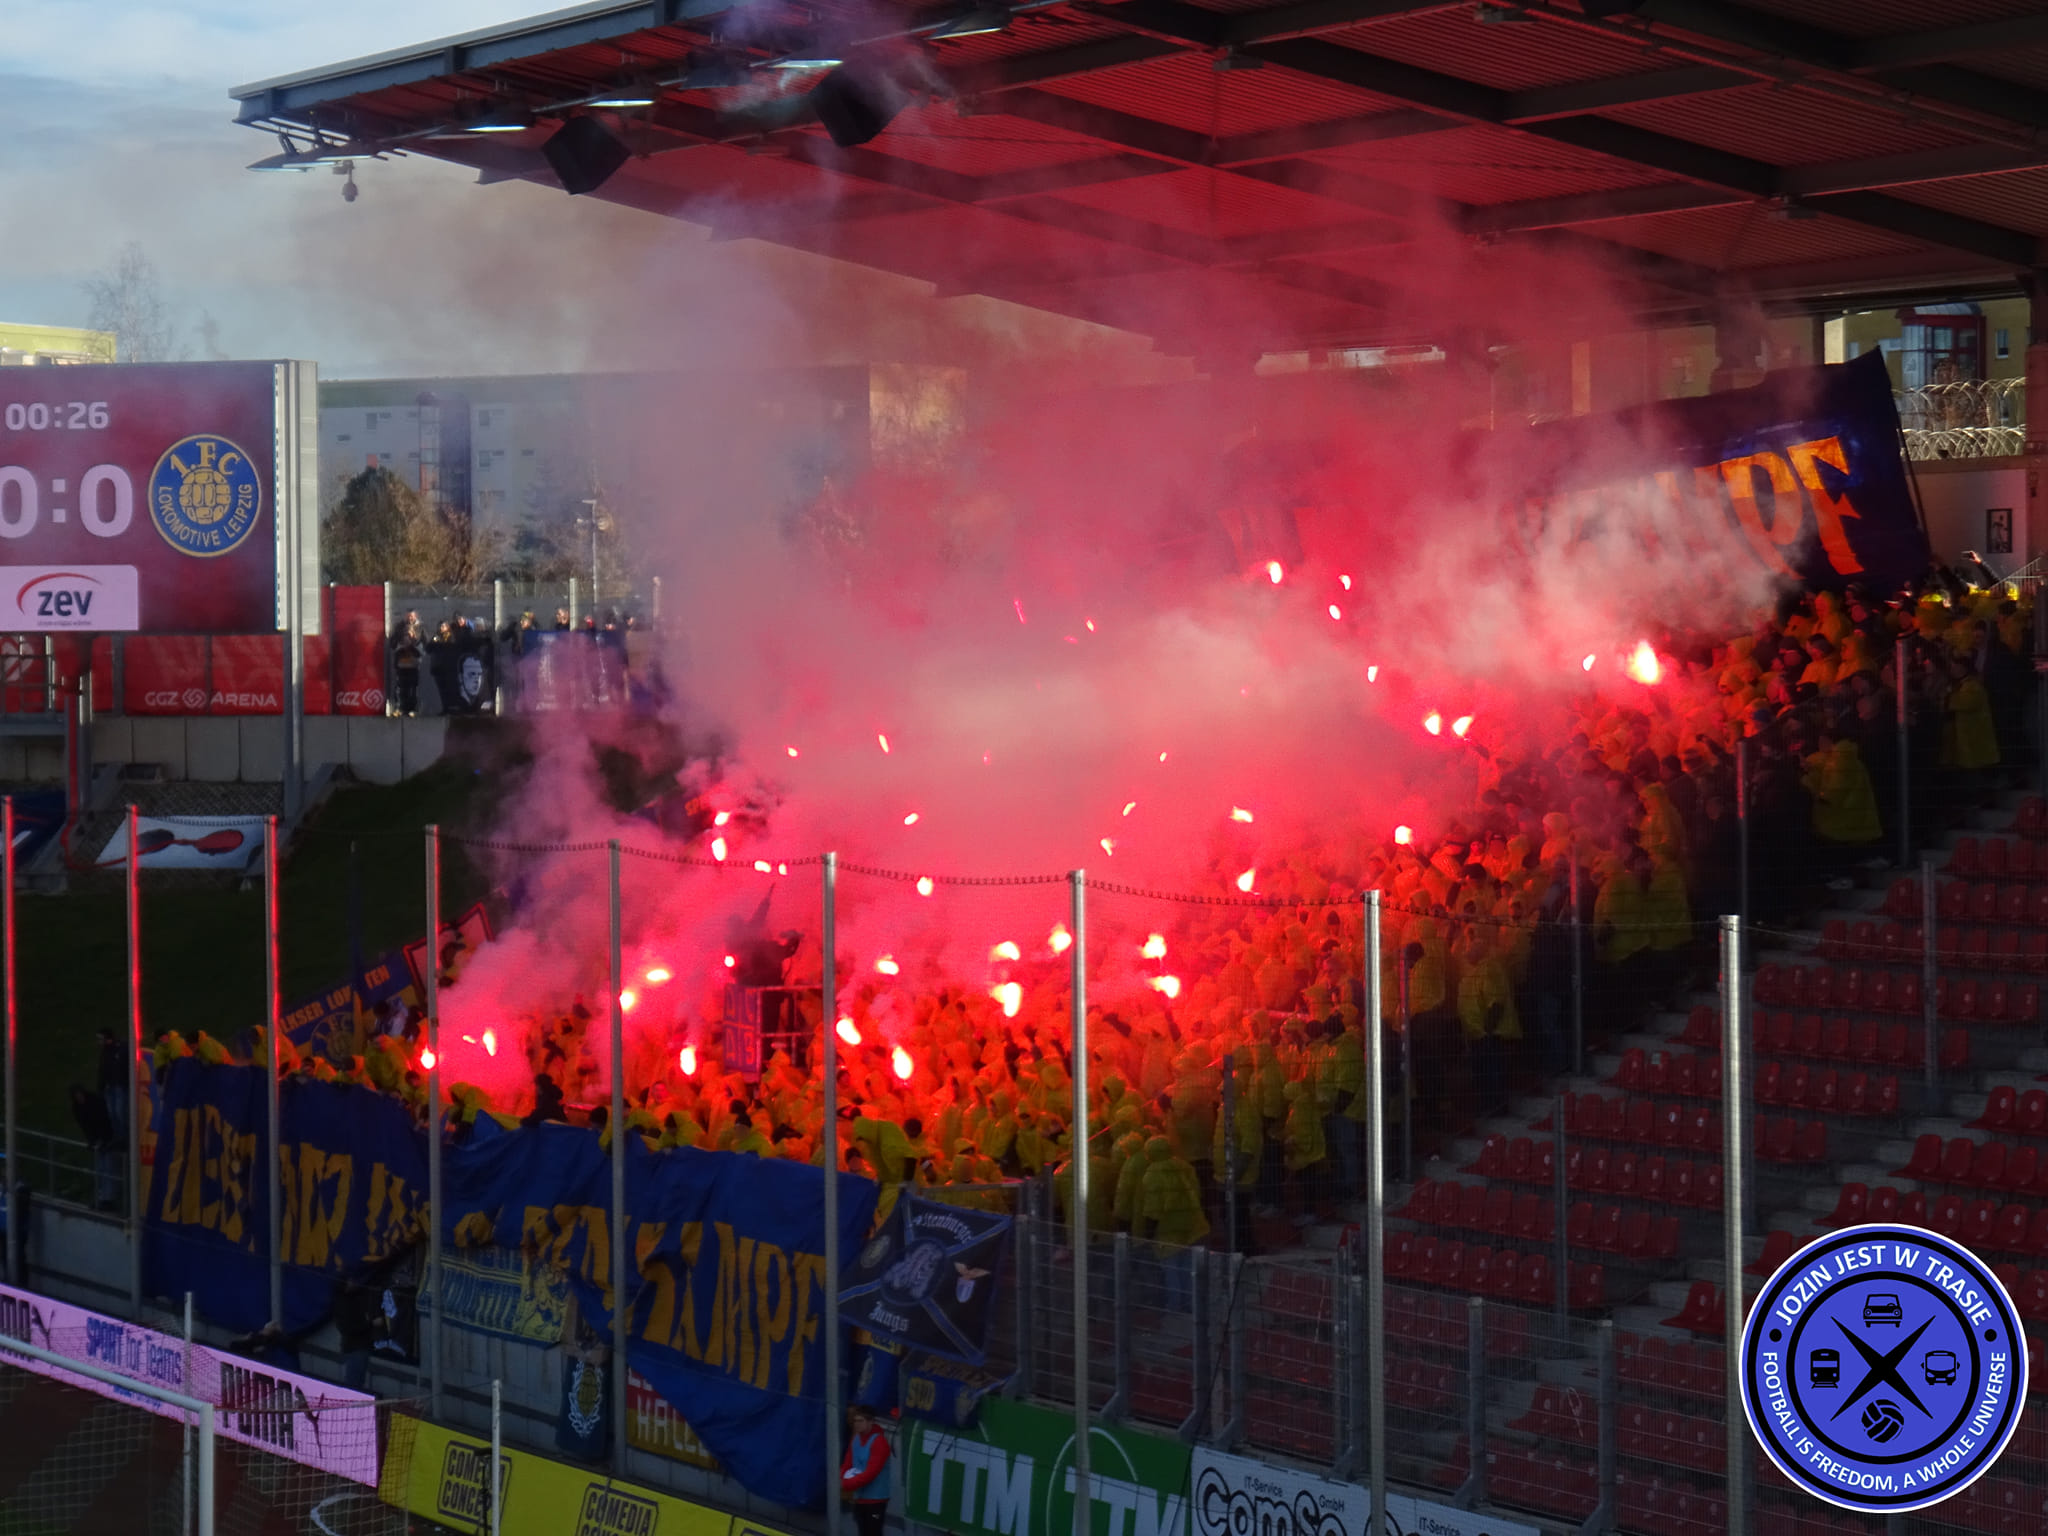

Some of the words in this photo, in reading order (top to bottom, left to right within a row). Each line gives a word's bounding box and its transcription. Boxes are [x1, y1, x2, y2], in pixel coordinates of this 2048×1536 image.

[5, 402, 110, 431] 00:26
[158, 486, 221, 548] LOKOMOTIVE
[223, 483, 254, 539] LEIPZIG
[37, 590, 93, 617] zev
[144, 691, 178, 707] GGZ
[210, 691, 278, 707] ARENA
[335, 691, 361, 707] GGZ
[86, 1317, 124, 1366] SPORT
[126, 1328, 142, 1372] for
[144, 1334, 182, 1385] Teams
[220, 1361, 294, 1451] PUMA
[921, 1429, 1034, 1536] TTM
[1243, 1475, 1284, 1498] IT-Service
[1318, 1493, 1345, 1513] GmbH
[585, 1490, 653, 1536] COMEDIA
